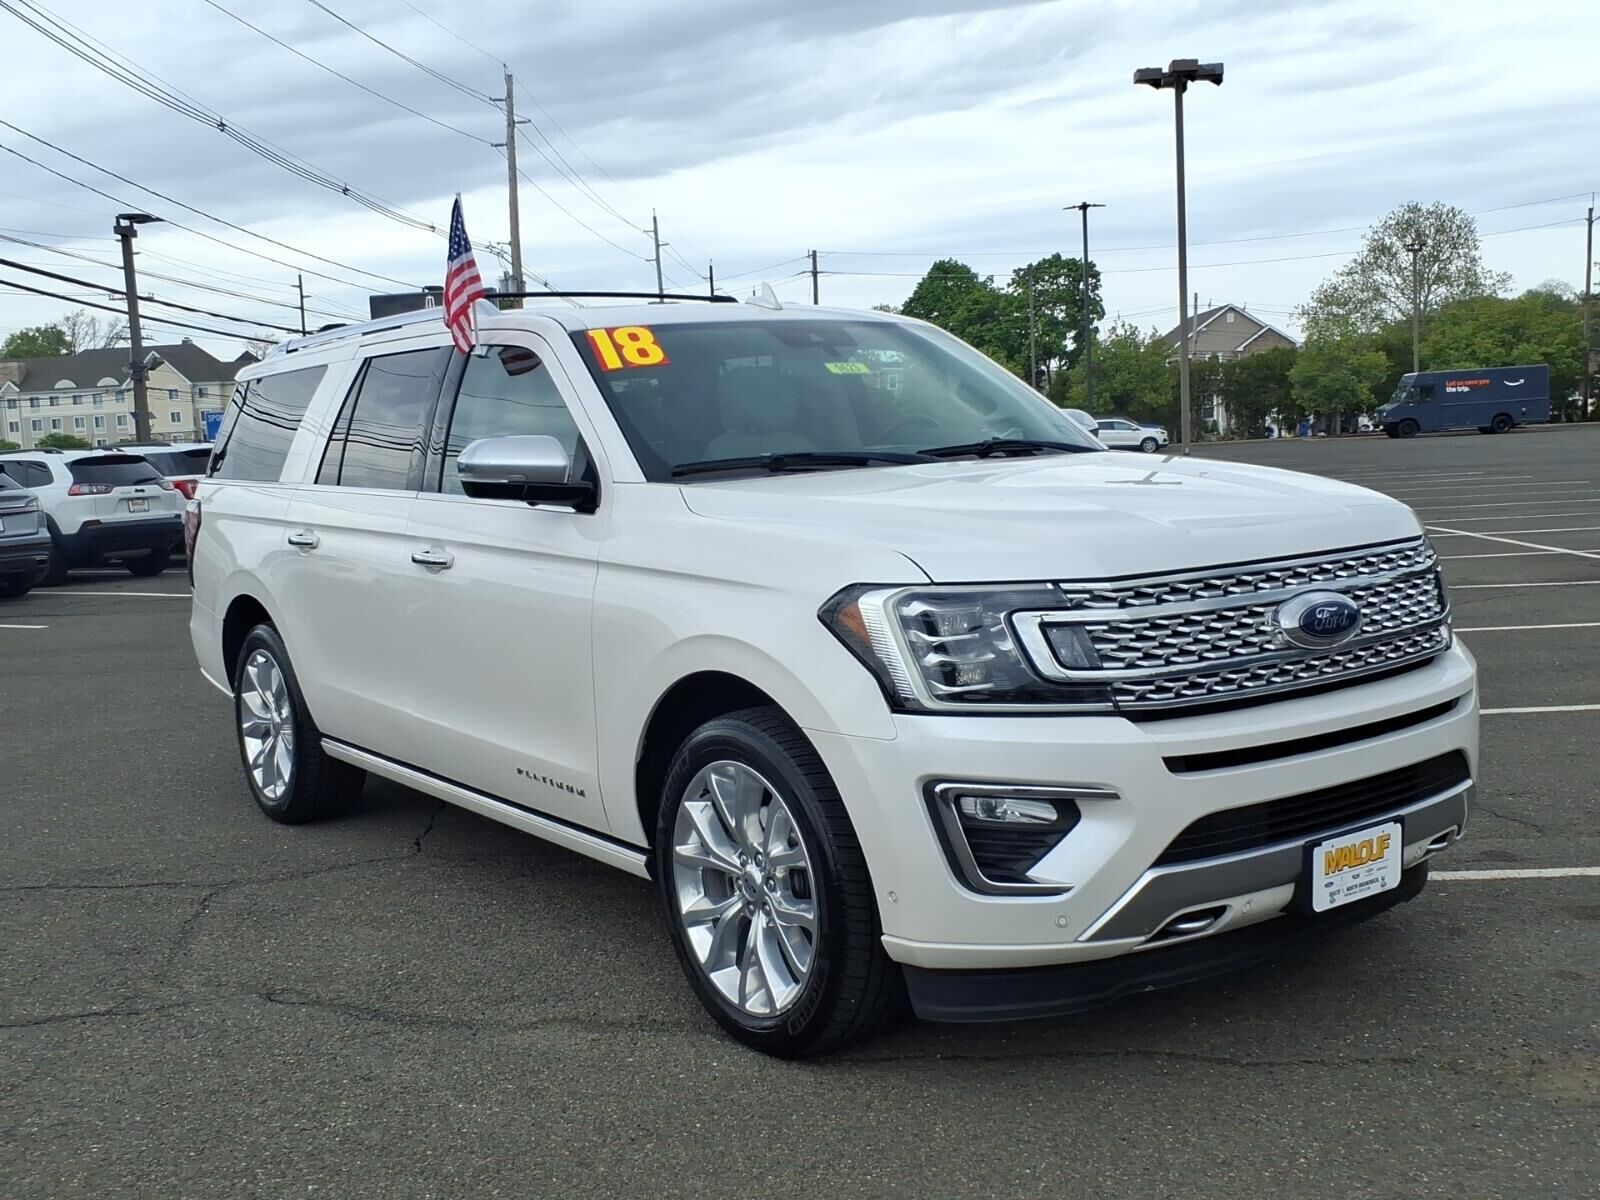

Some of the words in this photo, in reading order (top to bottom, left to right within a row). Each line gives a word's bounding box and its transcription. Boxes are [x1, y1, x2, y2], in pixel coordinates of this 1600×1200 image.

[588, 327, 664, 369] 18
[1314, 606, 1349, 630] Ford
[516, 767, 586, 798] PLATINUM
[1324, 833, 1391, 876] MALOUF
